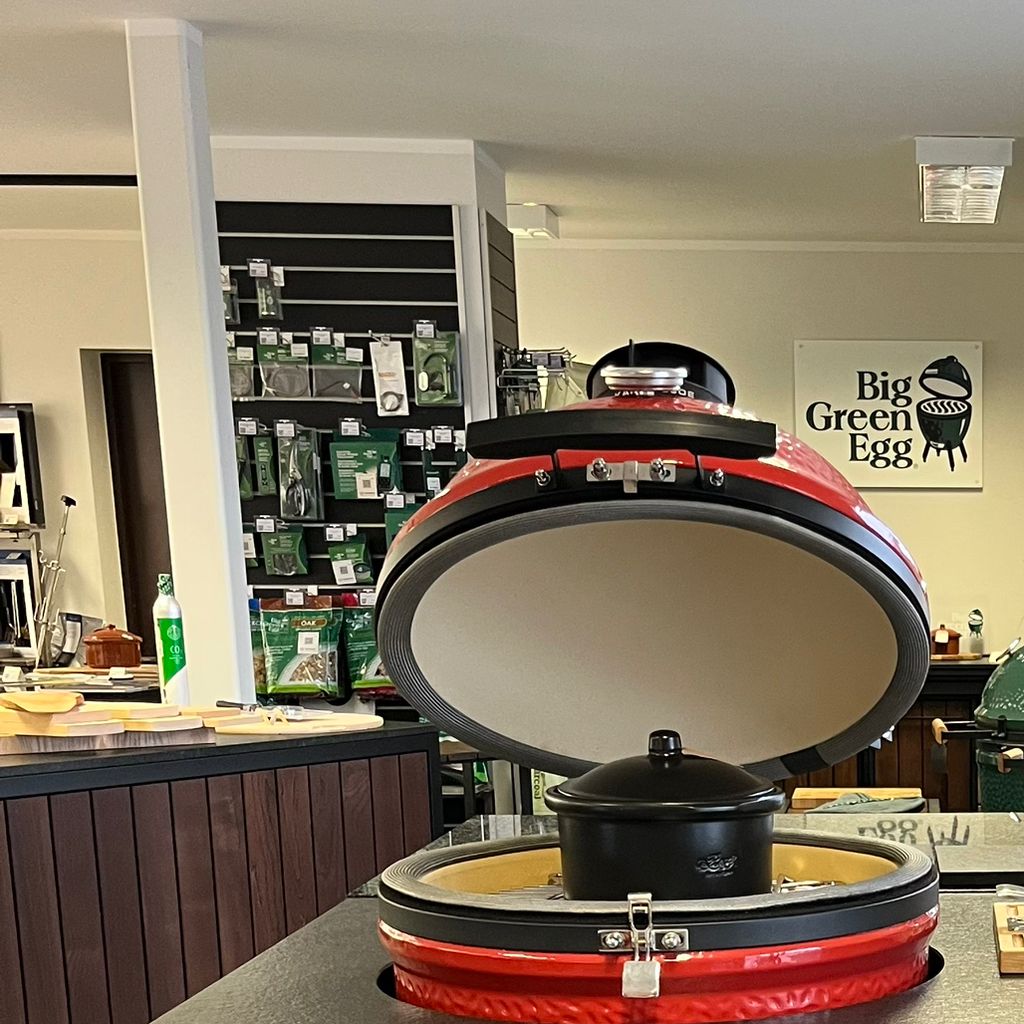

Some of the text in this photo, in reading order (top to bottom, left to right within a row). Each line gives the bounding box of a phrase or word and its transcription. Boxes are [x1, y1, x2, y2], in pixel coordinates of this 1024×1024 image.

[856, 370, 913, 408] Big
[806, 401, 914, 431] Green
[848, 433, 914, 469] Egg
[300, 619, 317, 627] OAK
